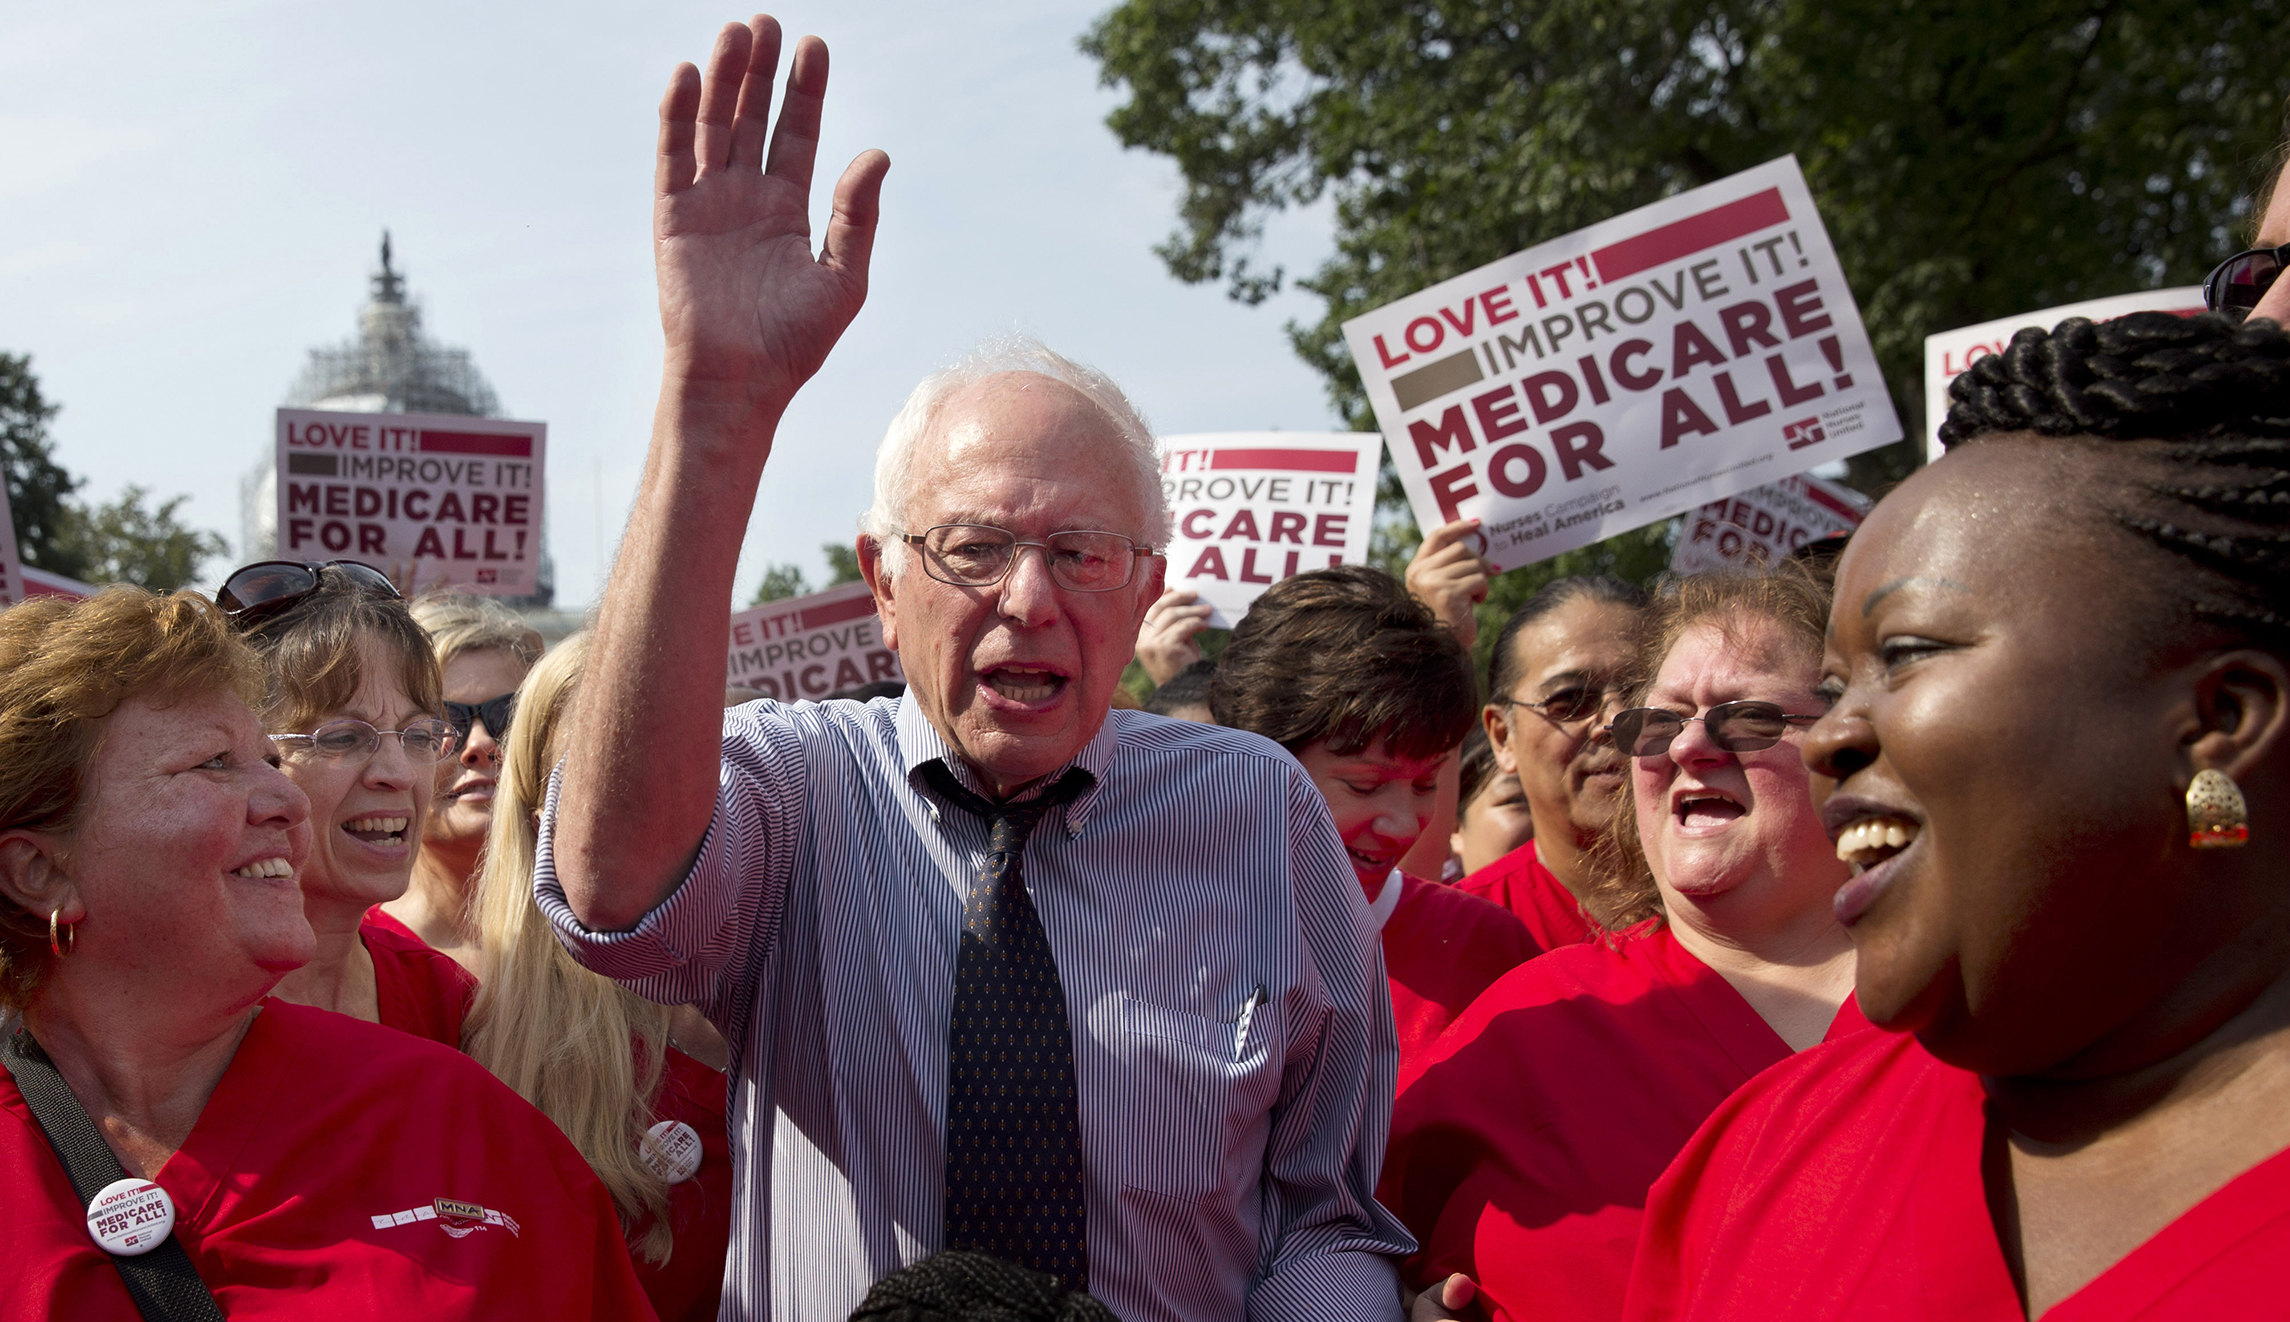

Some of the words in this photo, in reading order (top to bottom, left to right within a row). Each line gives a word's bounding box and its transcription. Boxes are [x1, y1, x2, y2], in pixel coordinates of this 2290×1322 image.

[1373, 284, 1519, 370] LOVE
[1526, 254, 1598, 309] IT!
[1482, 258, 1730, 375] IMPROVE
[1739, 231, 1809, 285] IT!
[1408, 277, 1833, 470] MEDICARE
[287, 422, 371, 449] LOVE
[380, 427, 417, 451] IT!
[1428, 421, 1617, 525] FOR
[1660, 334, 1854, 450] ALL!
[341, 455, 486, 486] IMPROVE
[496, 463, 532, 488] IT!
[288, 482, 530, 525] MEDICARE
[1164, 478, 1291, 501] PROVE
[1307, 481, 1354, 505] IT!
[1489, 510, 1542, 537] Nurses
[1543, 482, 1621, 518] Campaign
[1510, 523, 1550, 547] Heal
[1554, 499, 1626, 532] America
[289, 519, 387, 556] FOR
[413, 527, 527, 561] ALL!
[1181, 509, 1349, 547] CARE
[761, 612, 800, 640] IT!
[730, 623, 873, 676] IMPROVE
[675, 1137, 696, 1158] ALL!
[96, 1199, 164, 1229] MEDICARE
[100, 1192, 126, 1207] LOVE
[127, 1187, 140, 1197] IT!
[103, 1195, 146, 1216] IMPROVE
[146, 1191, 159, 1201] IT!
[441, 1202, 479, 1215] MNA
[99, 1221, 129, 1237] FOR
[135, 1208, 167, 1225] ALL!
